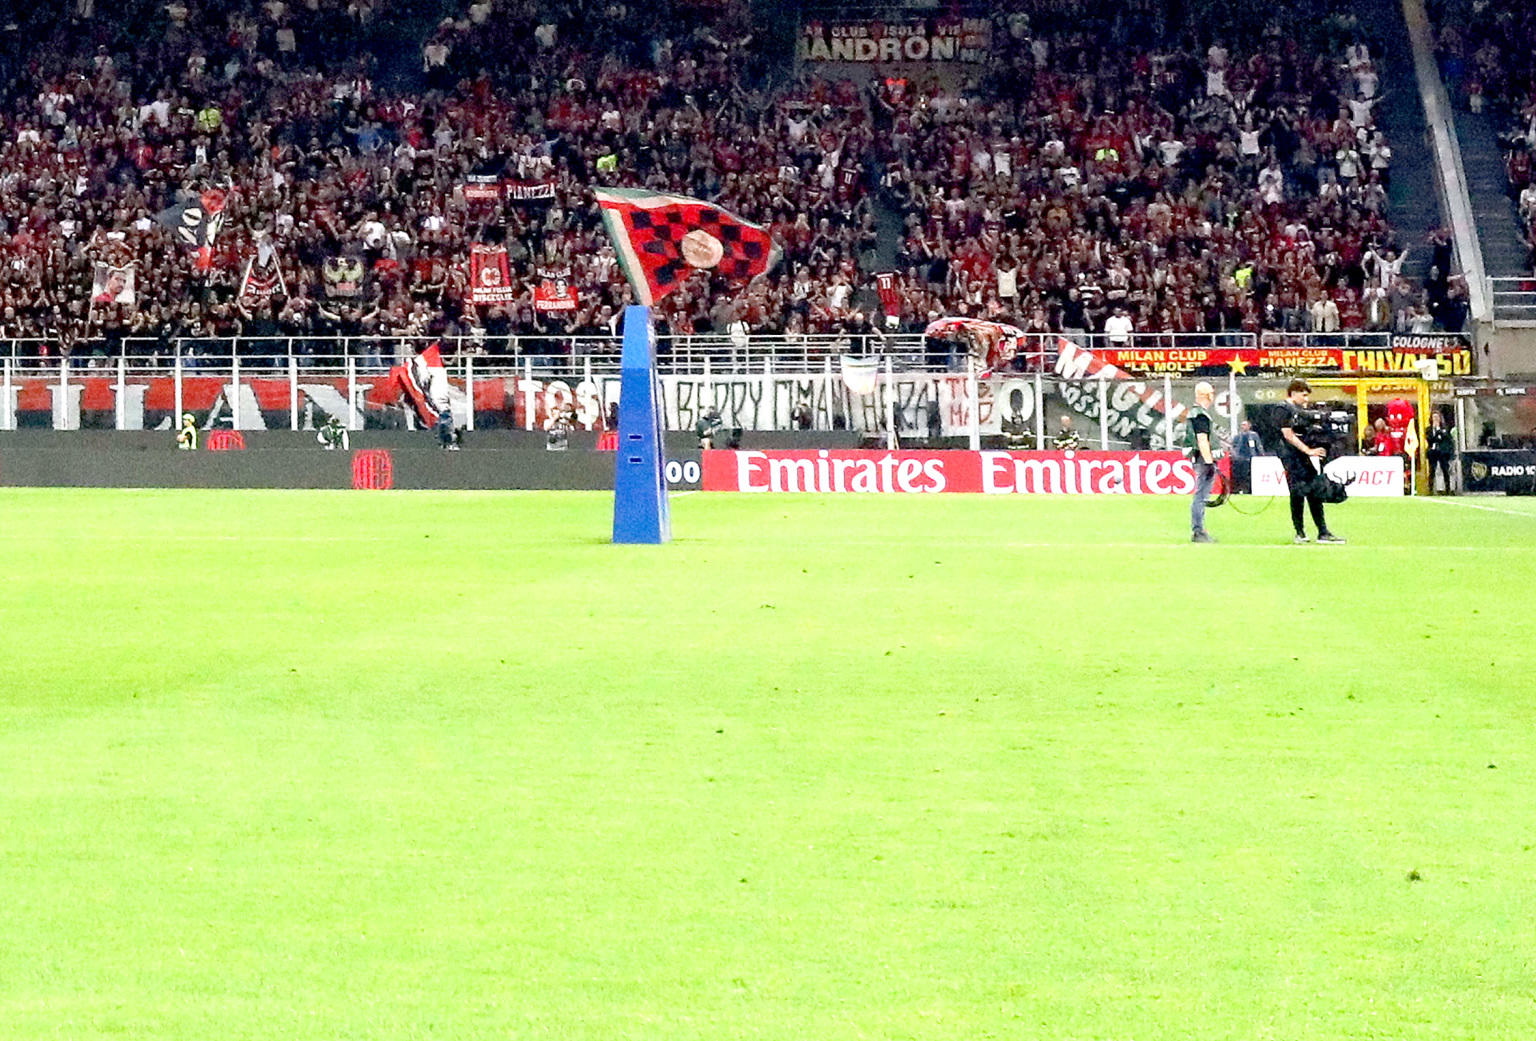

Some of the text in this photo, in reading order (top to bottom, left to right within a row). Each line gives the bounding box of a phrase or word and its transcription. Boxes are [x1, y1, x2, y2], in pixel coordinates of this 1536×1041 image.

[1117, 351, 1206, 361] MILAN CLUB
[1260, 357, 1338, 368] PIANEZZA
[736, 450, 947, 493] Emirates
[980, 450, 1196, 495] Emirates
[1491, 466, 1523, 478] RADIO
